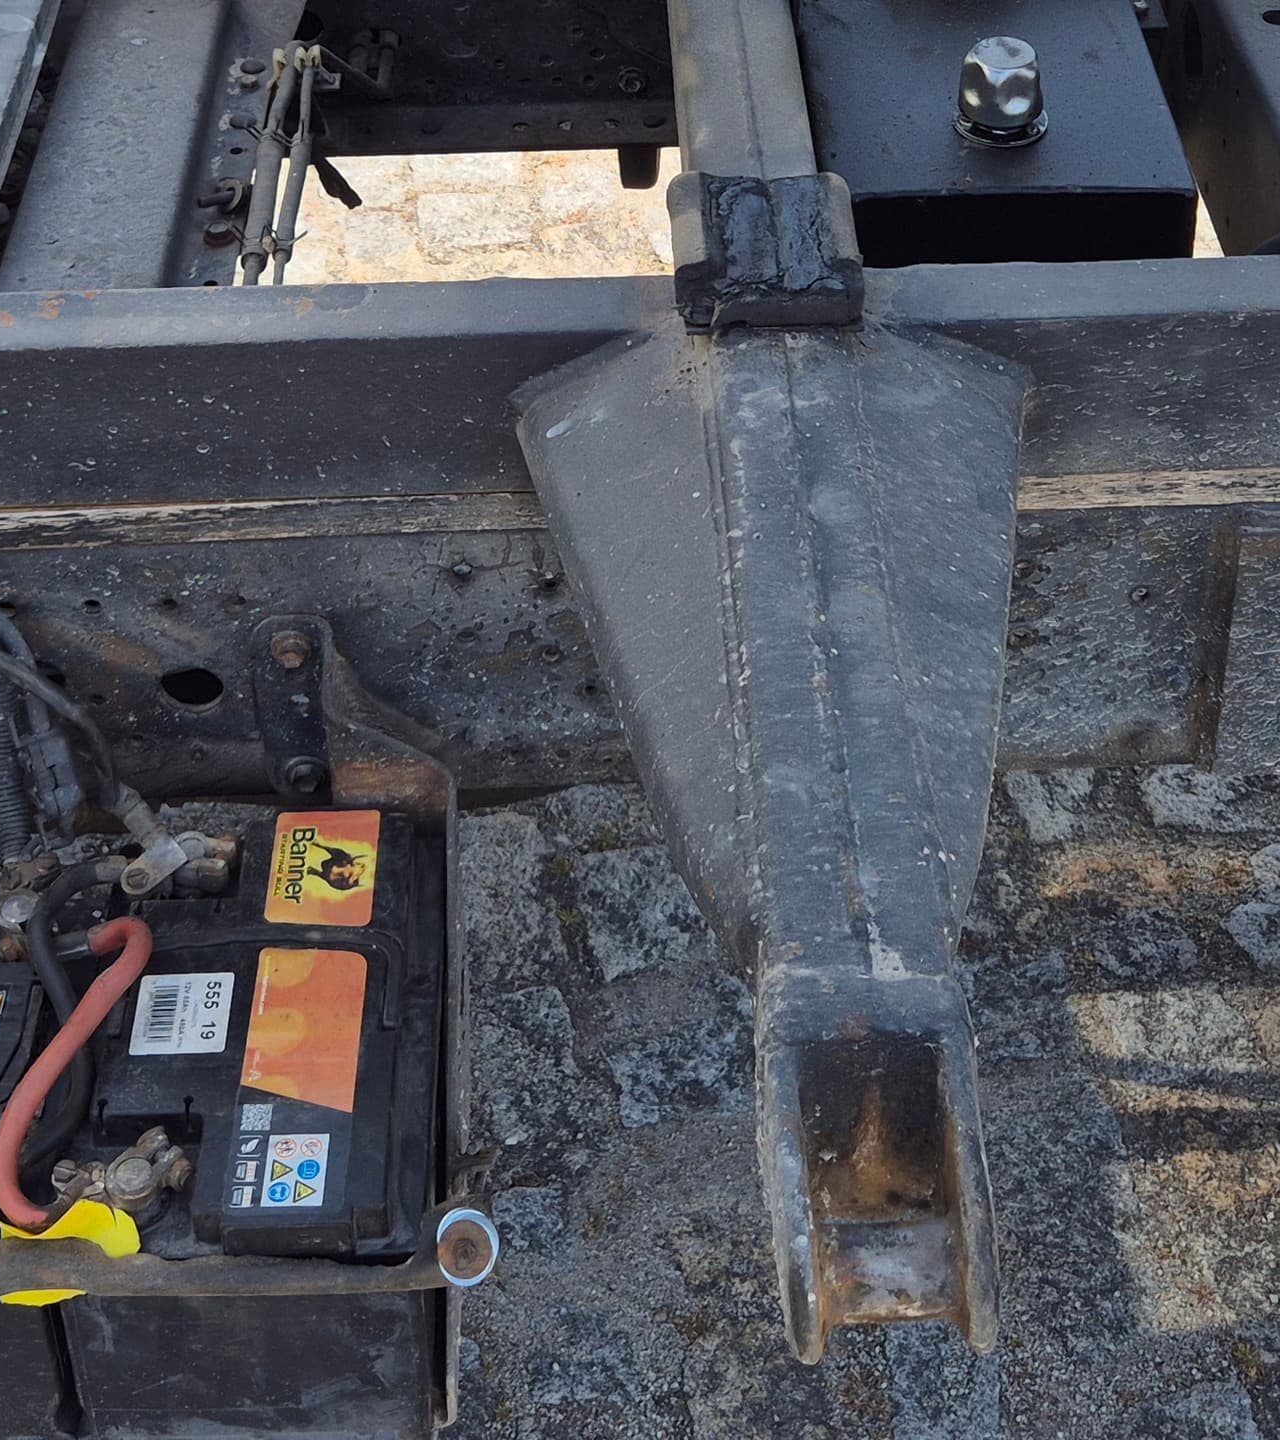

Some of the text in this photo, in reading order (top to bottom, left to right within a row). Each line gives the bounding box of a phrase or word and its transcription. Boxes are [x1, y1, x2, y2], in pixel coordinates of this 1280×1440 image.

[284, 827, 316, 904] Banner
[200, 981, 222, 1040] 555 19
